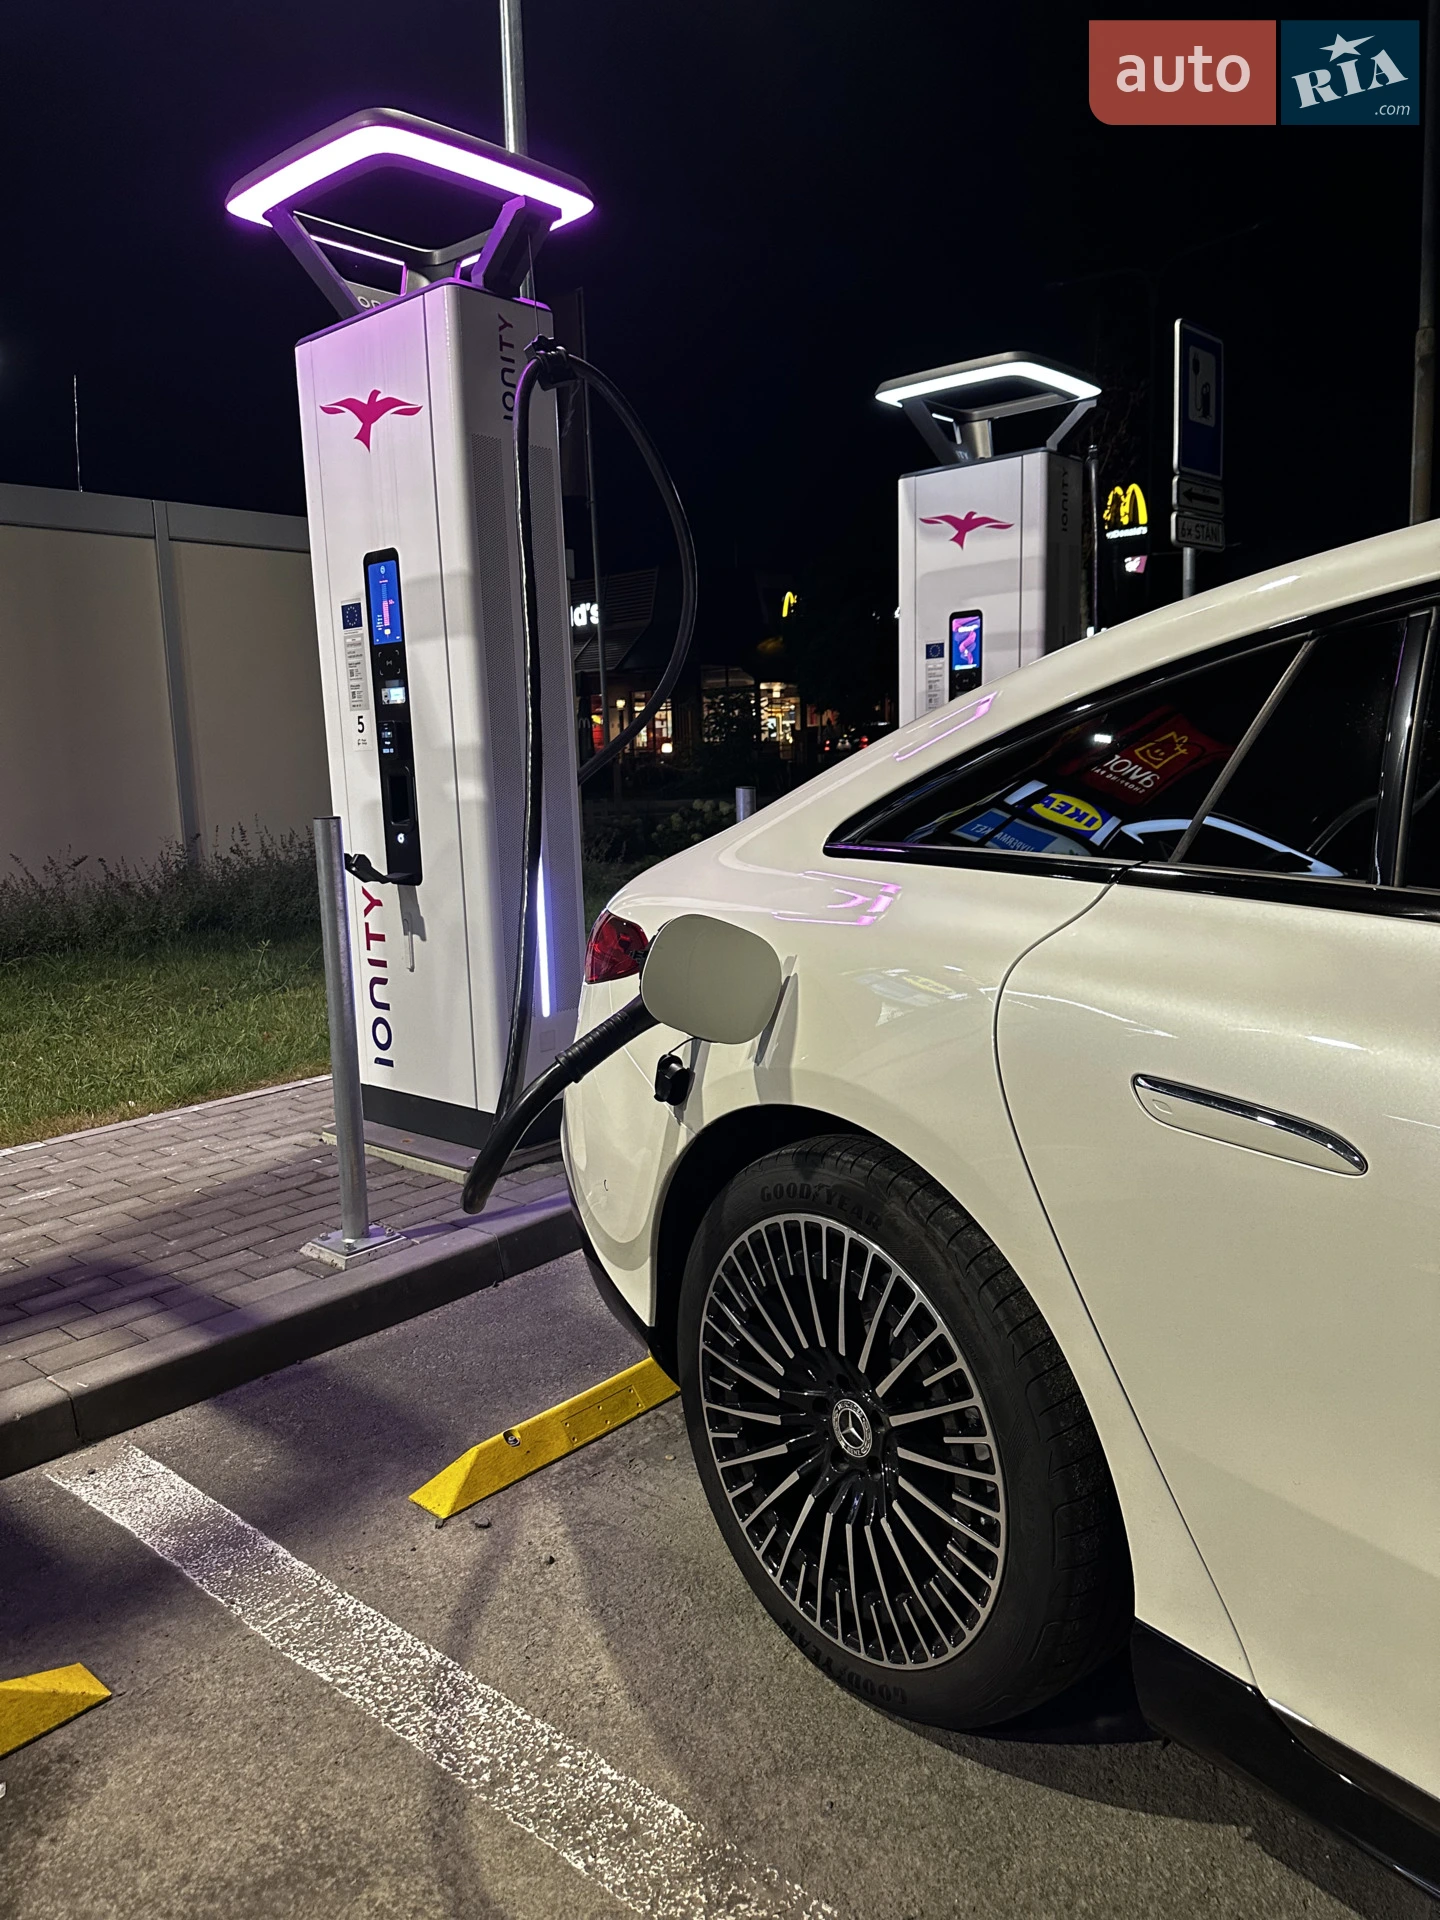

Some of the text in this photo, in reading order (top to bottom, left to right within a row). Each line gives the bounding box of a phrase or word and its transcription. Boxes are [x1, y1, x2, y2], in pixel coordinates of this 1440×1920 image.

[498, 313, 517, 421] IONITY
[357, 715, 365, 734] 5
[362, 886, 394, 1067] IONITY
